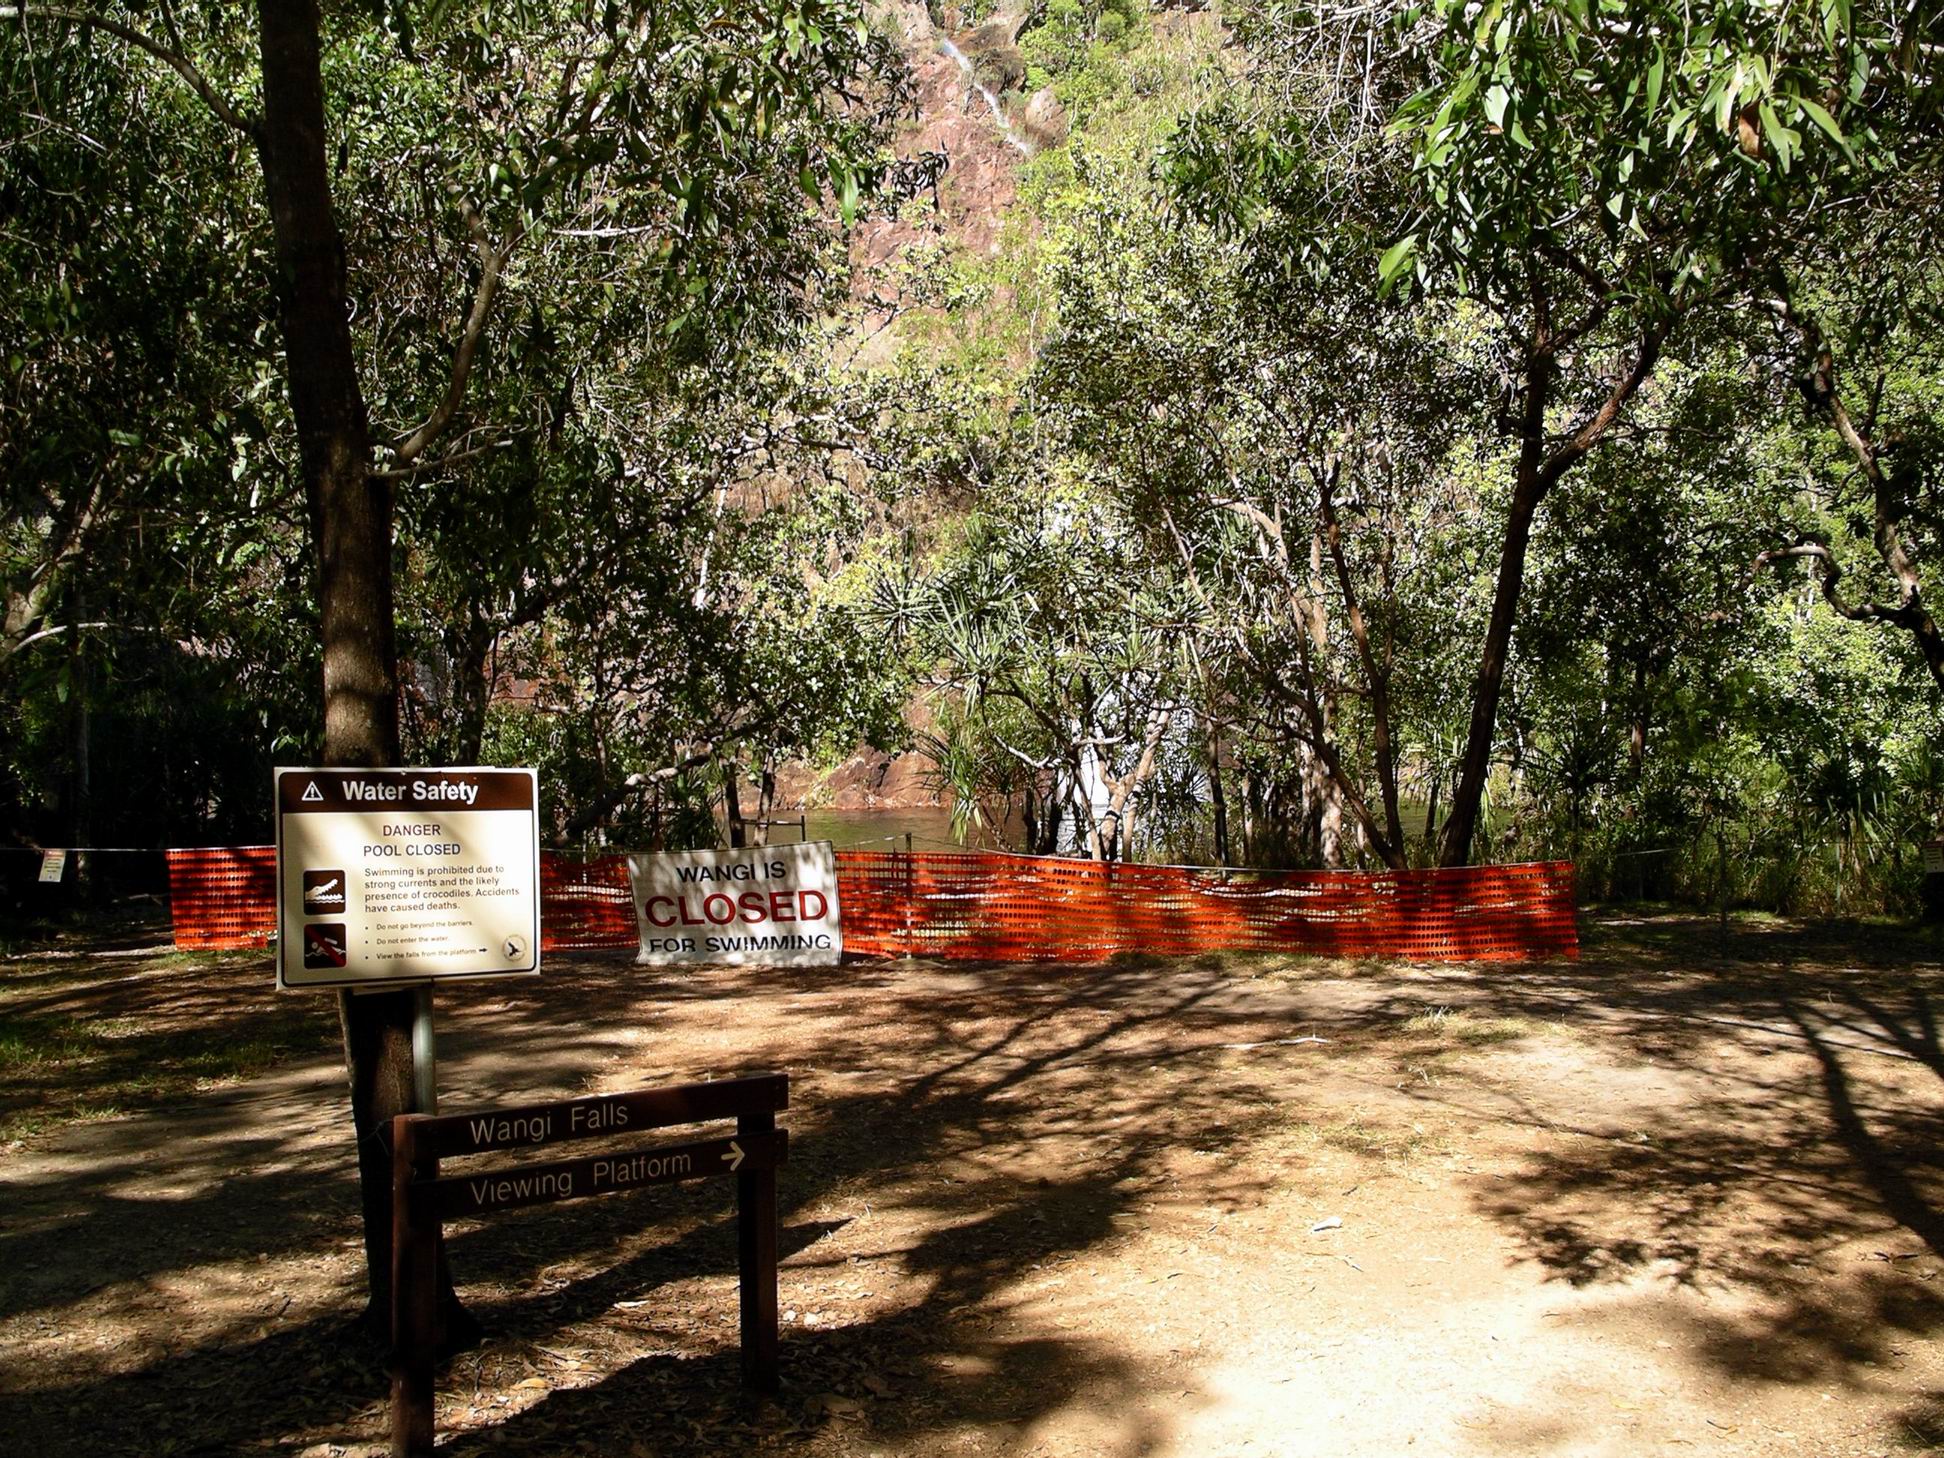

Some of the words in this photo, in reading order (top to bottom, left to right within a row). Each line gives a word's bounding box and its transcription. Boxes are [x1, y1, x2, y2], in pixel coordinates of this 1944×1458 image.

[343, 781, 406, 800] Water
[412, 779, 478, 804] Safety
[383, 825, 441, 836] DANGER
[364, 845, 401, 857] POOL
[406, 844, 461, 855] CLOSED
[365, 868, 414, 877] Swimming
[417, 867, 425, 875] is
[427, 866, 474, 876] prohibited
[476, 865, 493, 874] due
[677, 864, 755, 882] WANGI
[765, 862, 786, 878] IS
[365, 881, 395, 889] strong
[399, 879, 437, 887] currents
[440, 878, 457, 886] and
[476, 877, 499, 886] likely
[365, 893, 408, 902] presence
[411, 891, 420, 900] of
[423, 890, 473, 899] crocodiles.
[476, 888, 519, 896] Accidents
[365, 904, 388, 913] have
[391, 904, 424, 912] caused
[427, 902, 460, 910] deaths.
[645, 890, 828, 928] CLOSED
[650, 938, 696, 952] FOR
[706, 935, 831, 952] SWIMMING
[471, 1112, 552, 1145] Wangi
[571, 1103, 628, 1132] Falls
[471, 1172, 572, 1205] Viewing
[594, 1151, 690, 1187] Platform
